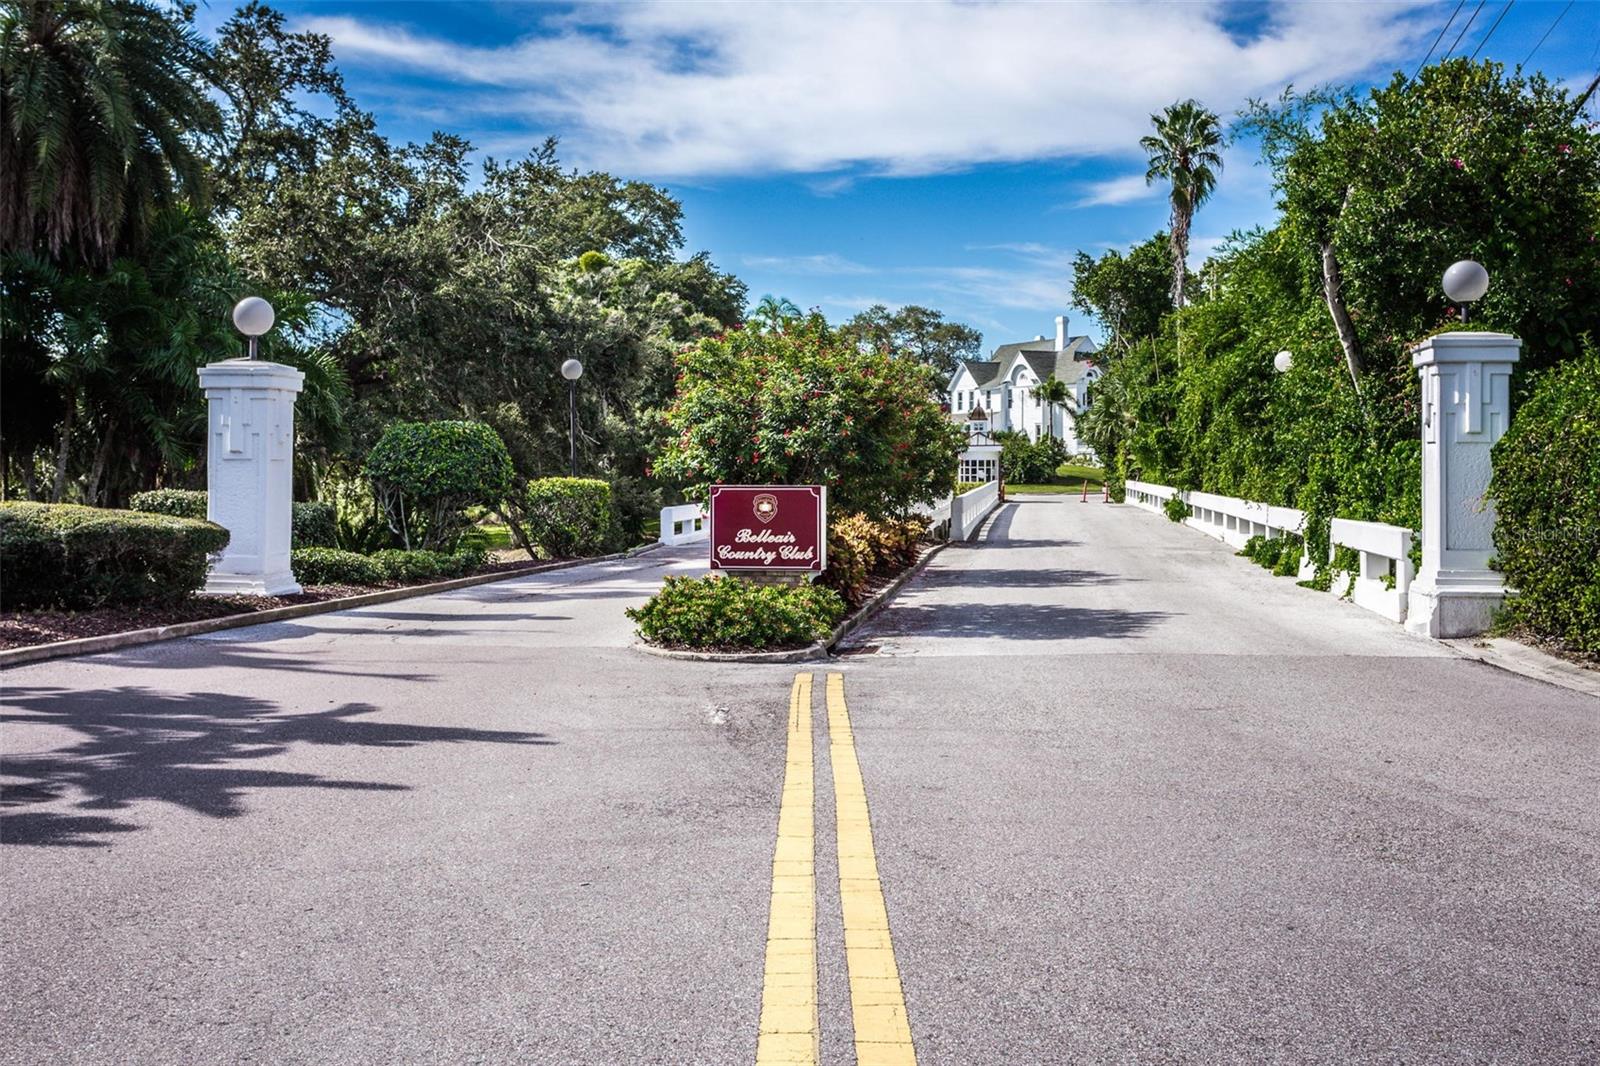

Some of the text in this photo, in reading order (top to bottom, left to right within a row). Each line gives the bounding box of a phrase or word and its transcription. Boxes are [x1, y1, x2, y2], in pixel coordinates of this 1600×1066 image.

[735, 529, 796, 543] Belleair
[717, 545, 814, 565] Country Club
